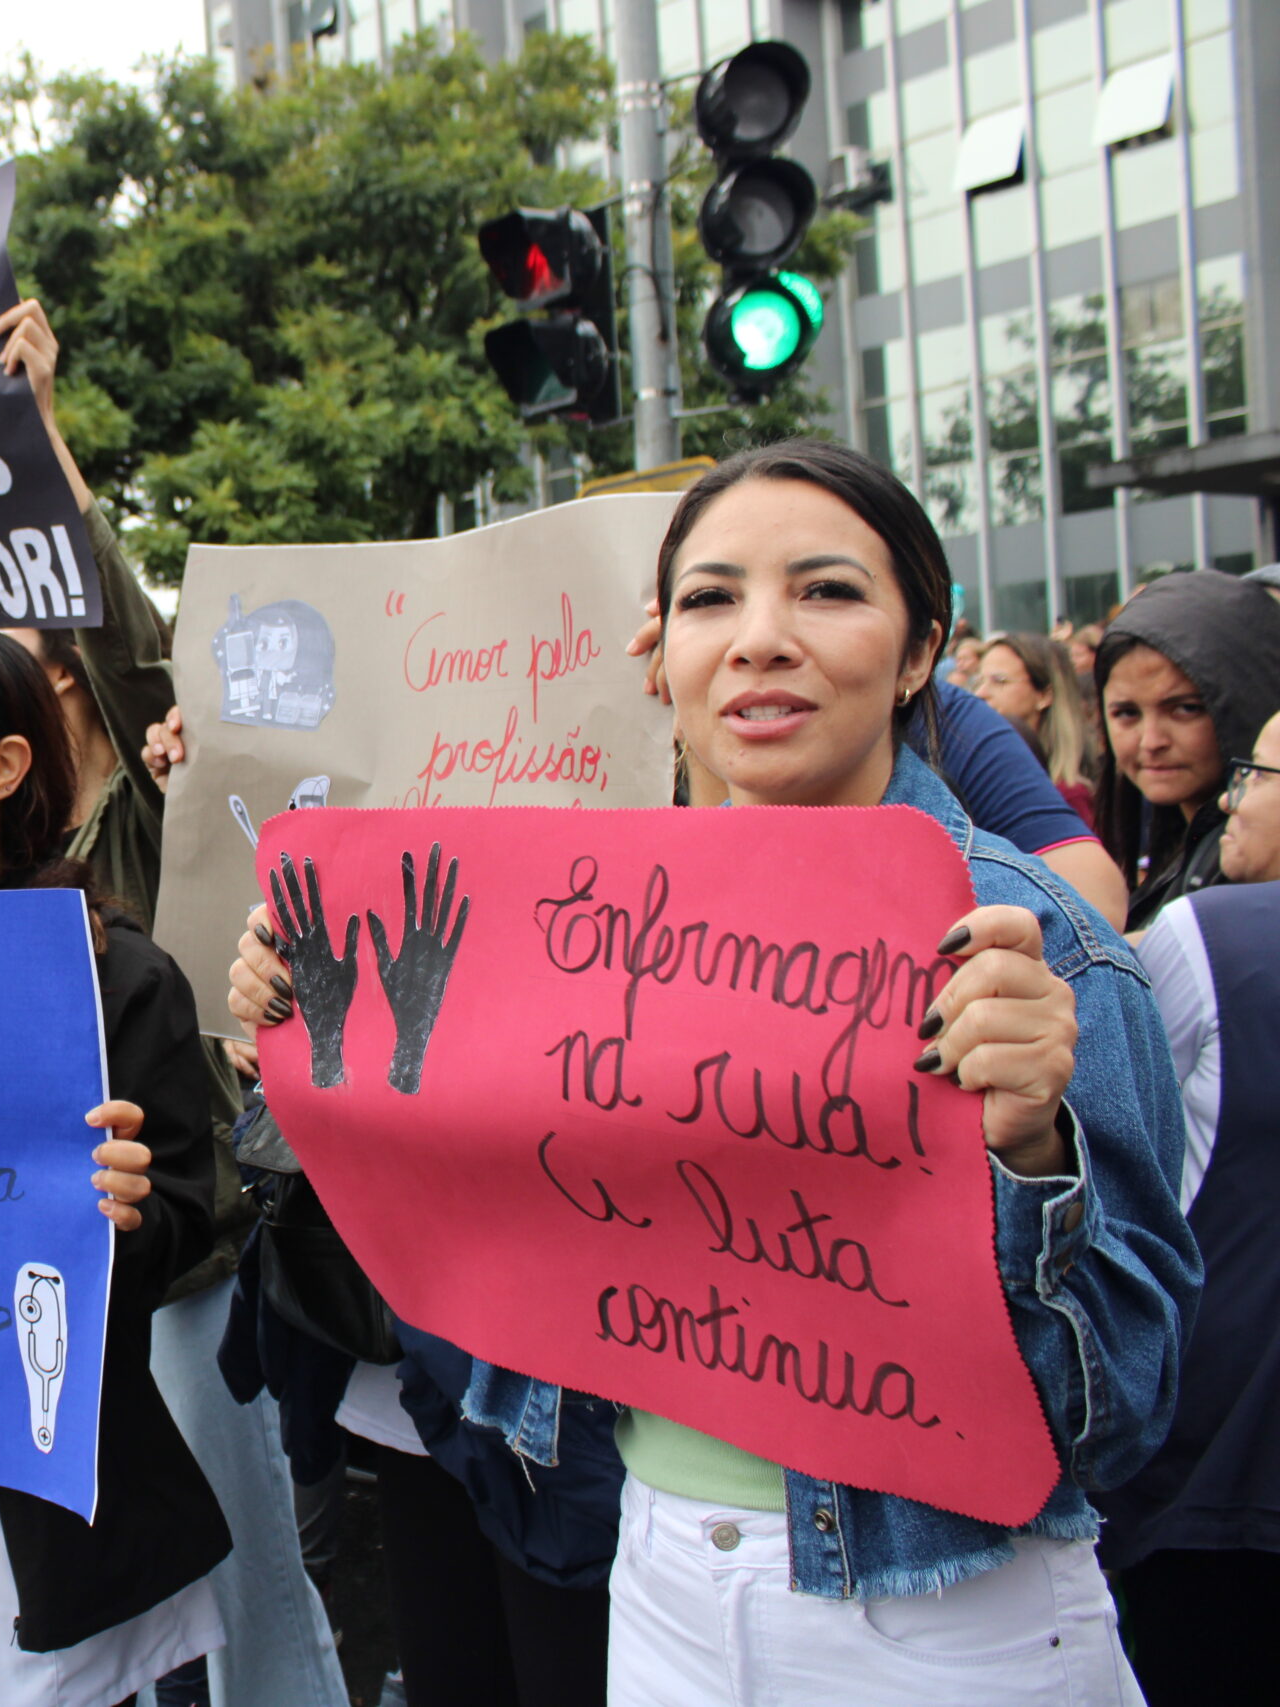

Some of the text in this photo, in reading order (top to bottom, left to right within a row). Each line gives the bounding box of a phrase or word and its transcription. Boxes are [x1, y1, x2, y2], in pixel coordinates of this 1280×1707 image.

[526, 592, 601, 723] pela
[545, 1030, 933, 1176] na rua!
[675, 1159, 910, 1308] luta
[596, 1284, 966, 1440] continua.
